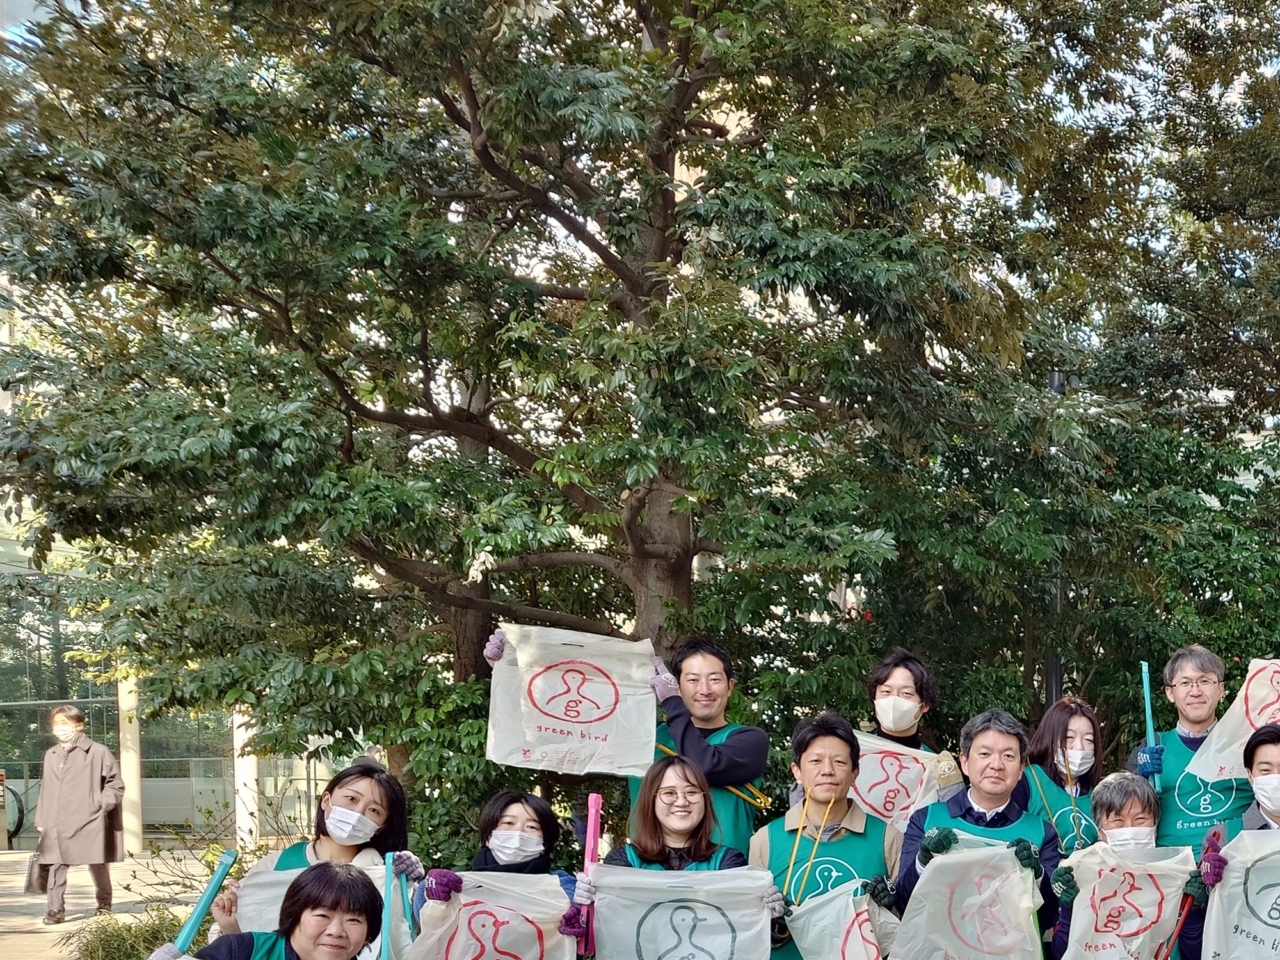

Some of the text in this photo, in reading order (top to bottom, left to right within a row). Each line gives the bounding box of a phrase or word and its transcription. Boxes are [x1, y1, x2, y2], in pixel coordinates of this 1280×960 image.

[536, 725, 608, 742] green bird
[1176, 820, 1211, 830] green
[1233, 924, 1265, 946] green
